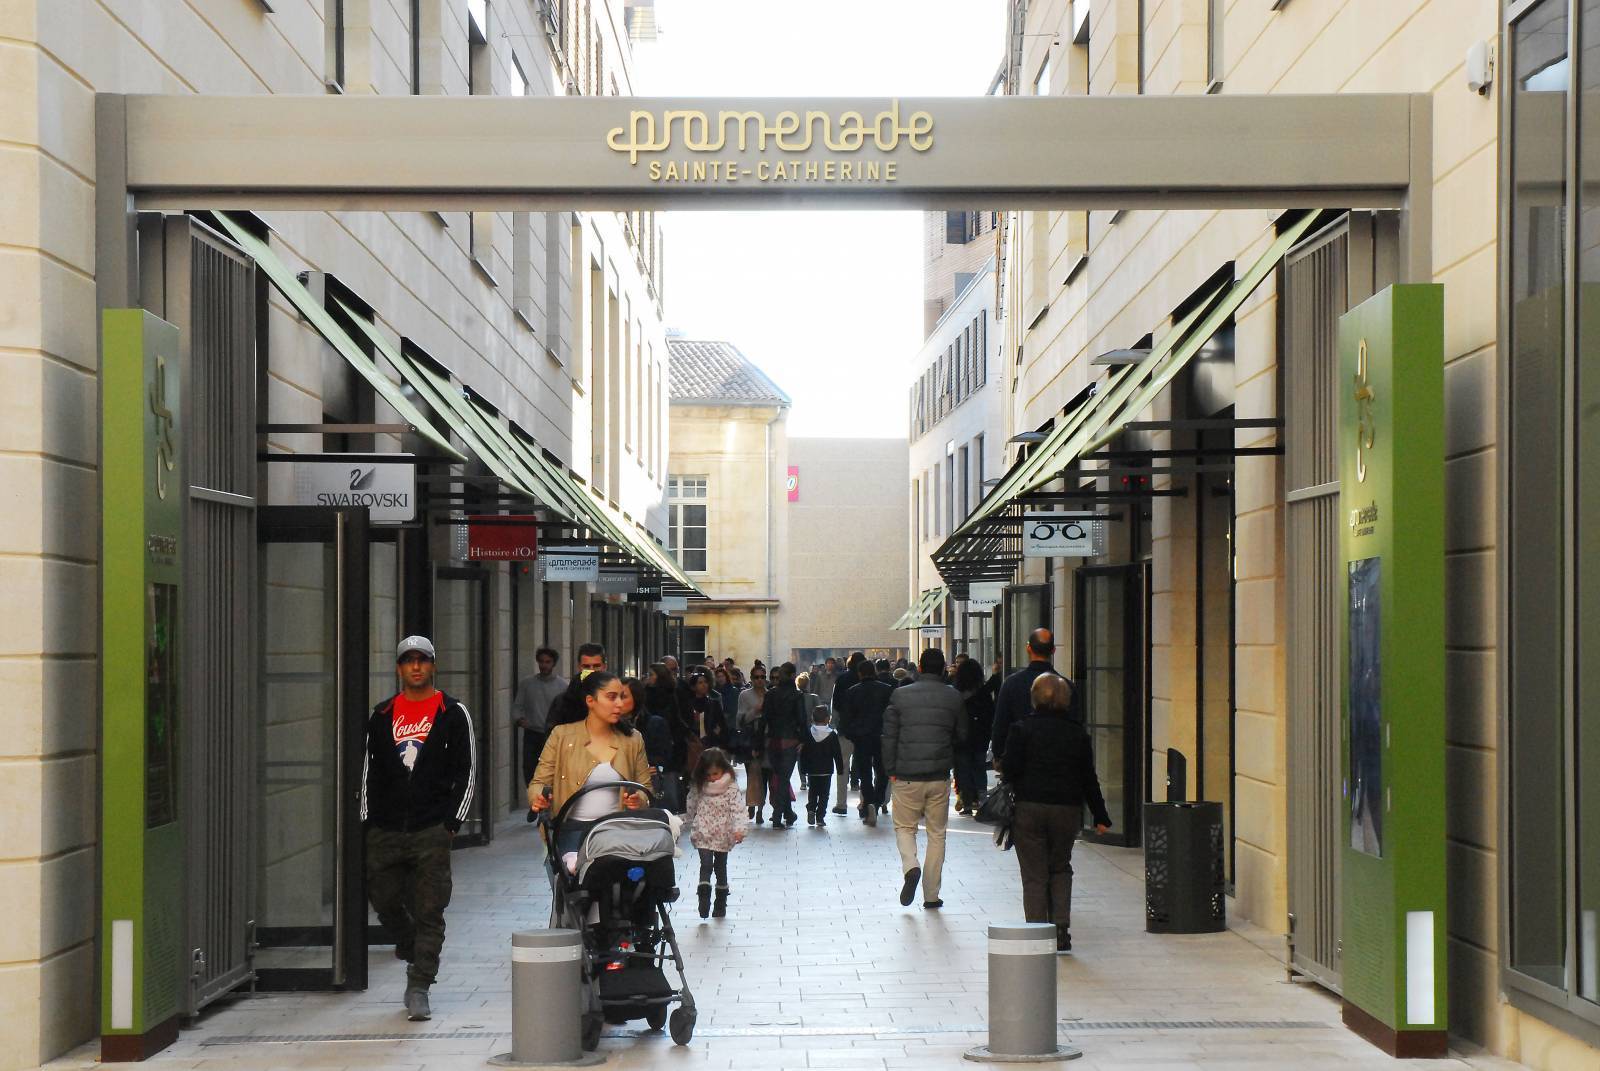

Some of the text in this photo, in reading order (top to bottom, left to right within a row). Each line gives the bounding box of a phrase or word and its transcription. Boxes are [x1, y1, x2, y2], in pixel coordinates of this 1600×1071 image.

[607, 98, 934, 165] promenade
[649, 161, 898, 181] SAINTE-CATHERINE
[317, 493, 409, 508] SWAROVSKI
[470, 546, 536, 557] Histoire d'Or
